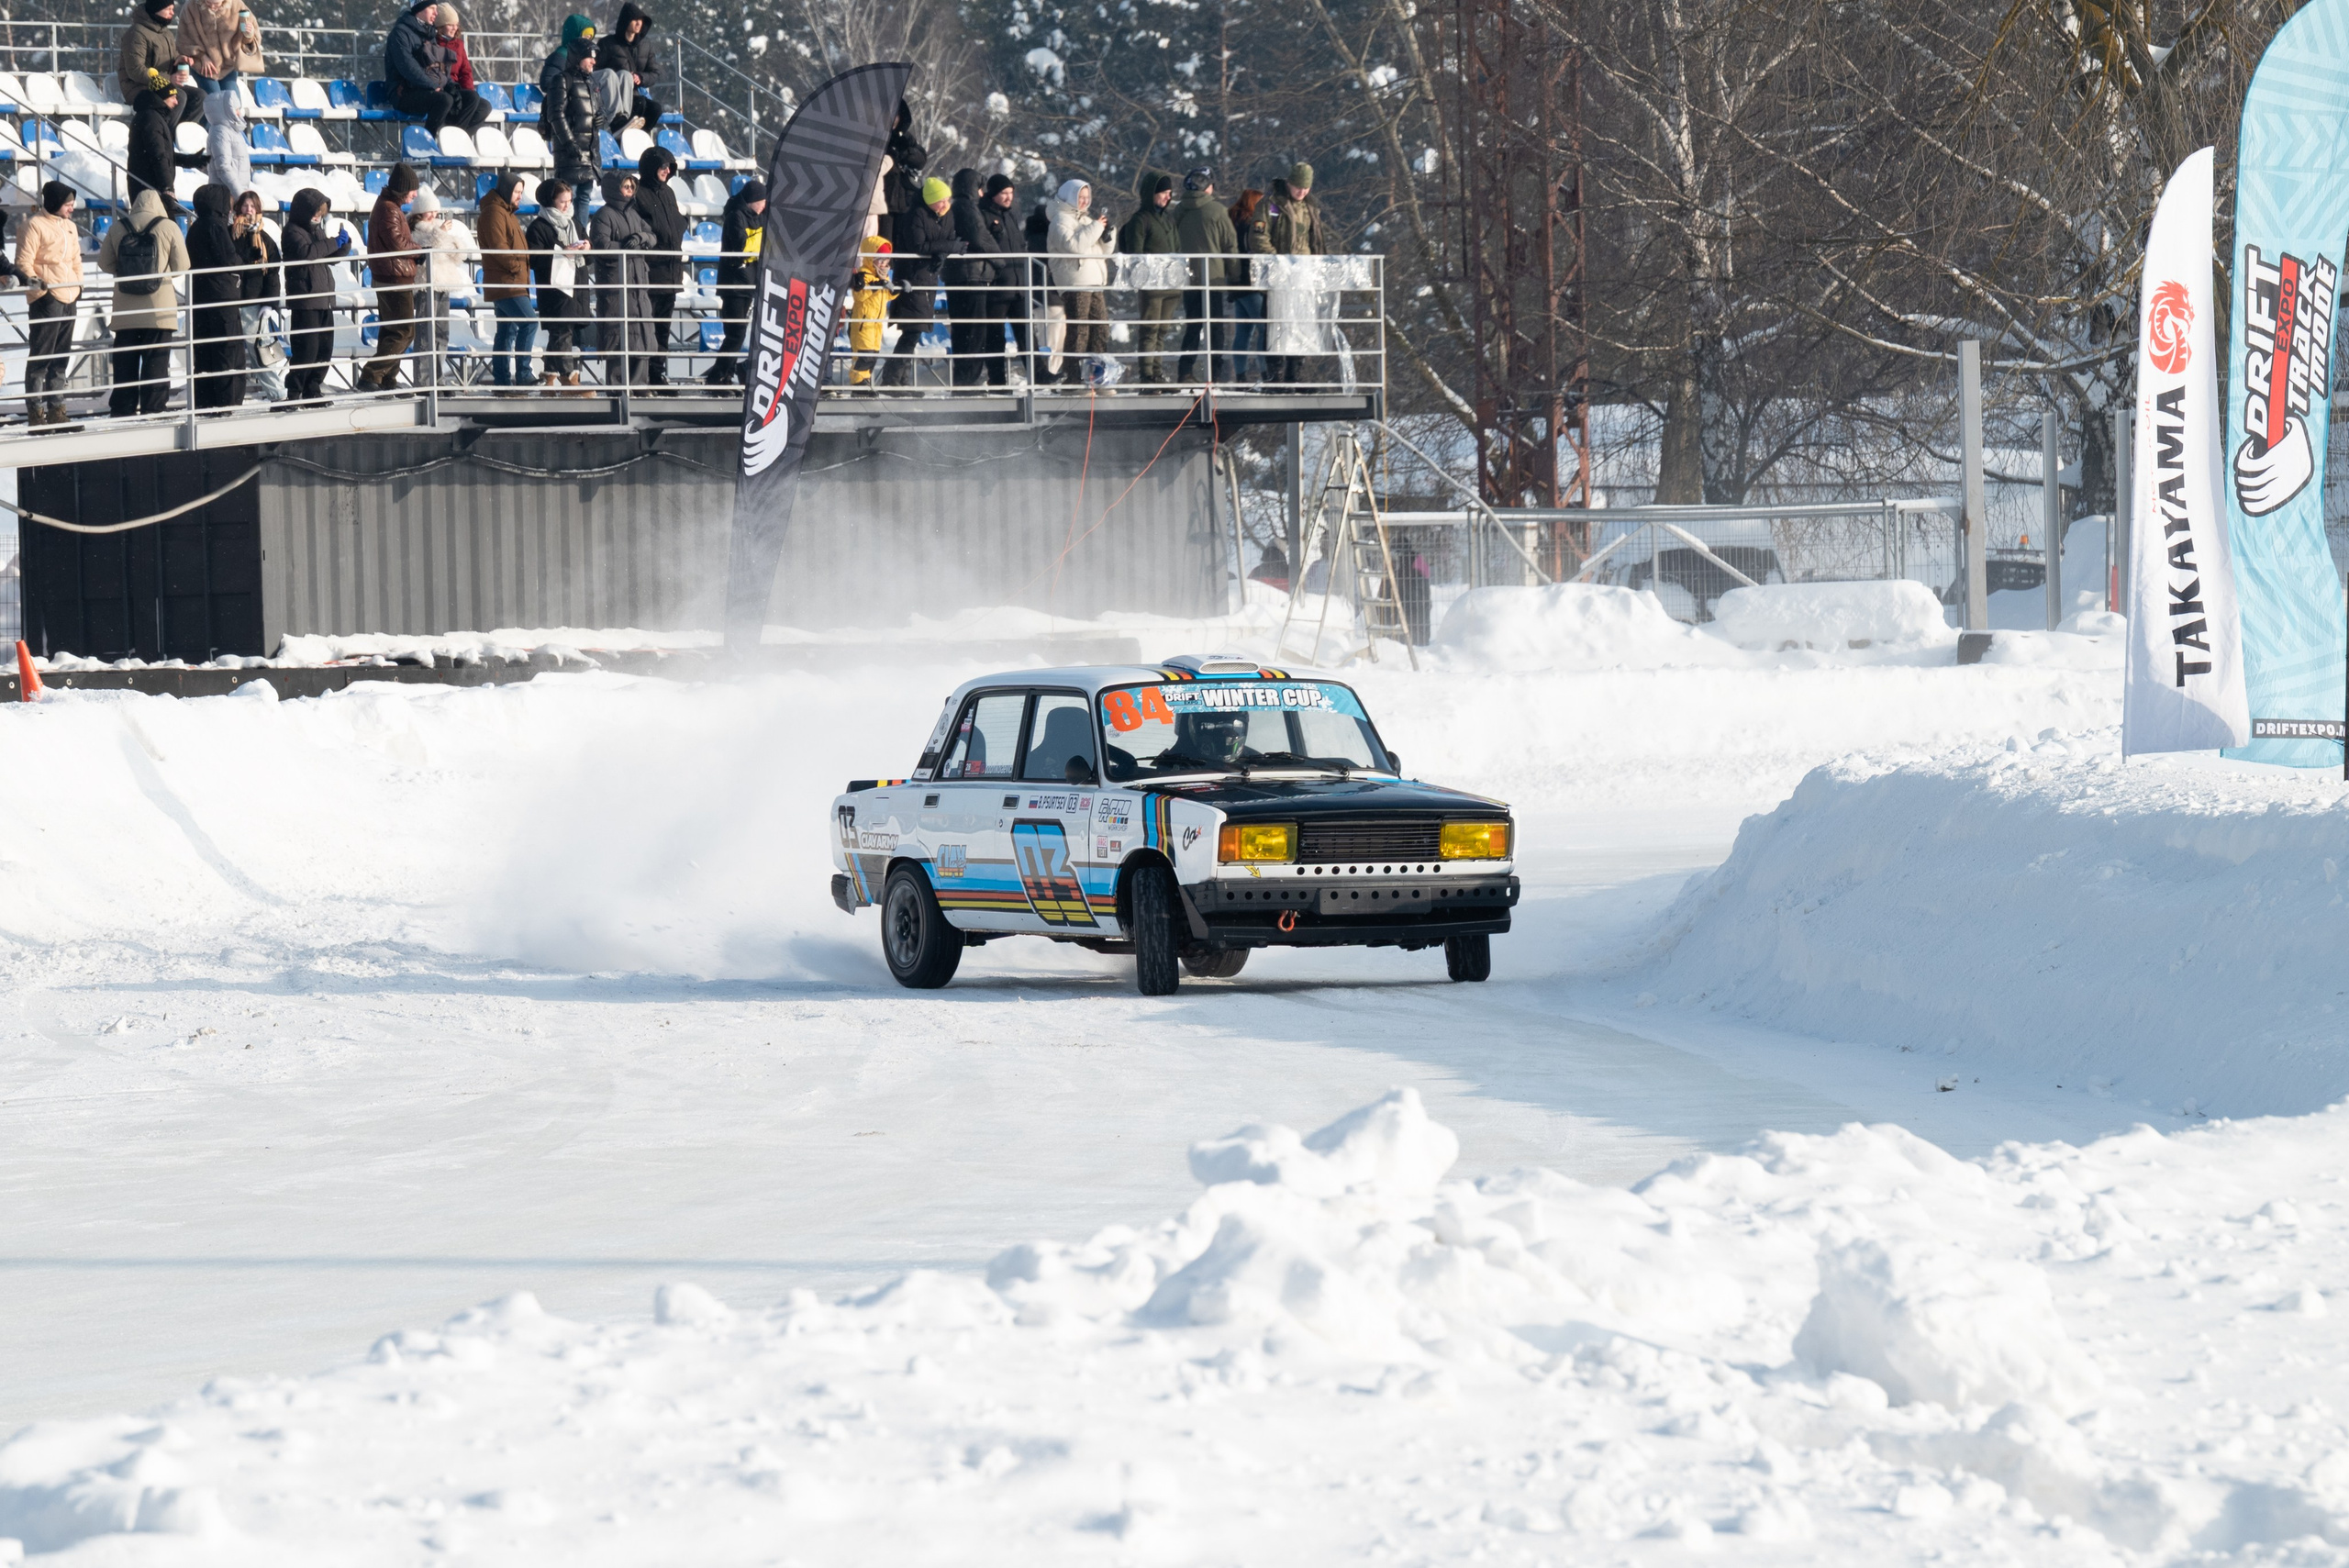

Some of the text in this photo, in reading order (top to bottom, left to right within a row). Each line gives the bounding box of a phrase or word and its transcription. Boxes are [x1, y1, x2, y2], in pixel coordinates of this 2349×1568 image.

[751, 268, 788, 419] DRIFT
[785, 294, 803, 355] EXPO
[2246, 246, 2281, 439] DRIFT
[2277, 278, 2295, 352] EXPO
[2157, 384, 2212, 687] TAKAYAMA
[1104, 686, 1174, 731] 84
[1165, 688, 1323, 707] DRIFT WINTER CUP
[1067, 795, 1079, 811] 03
